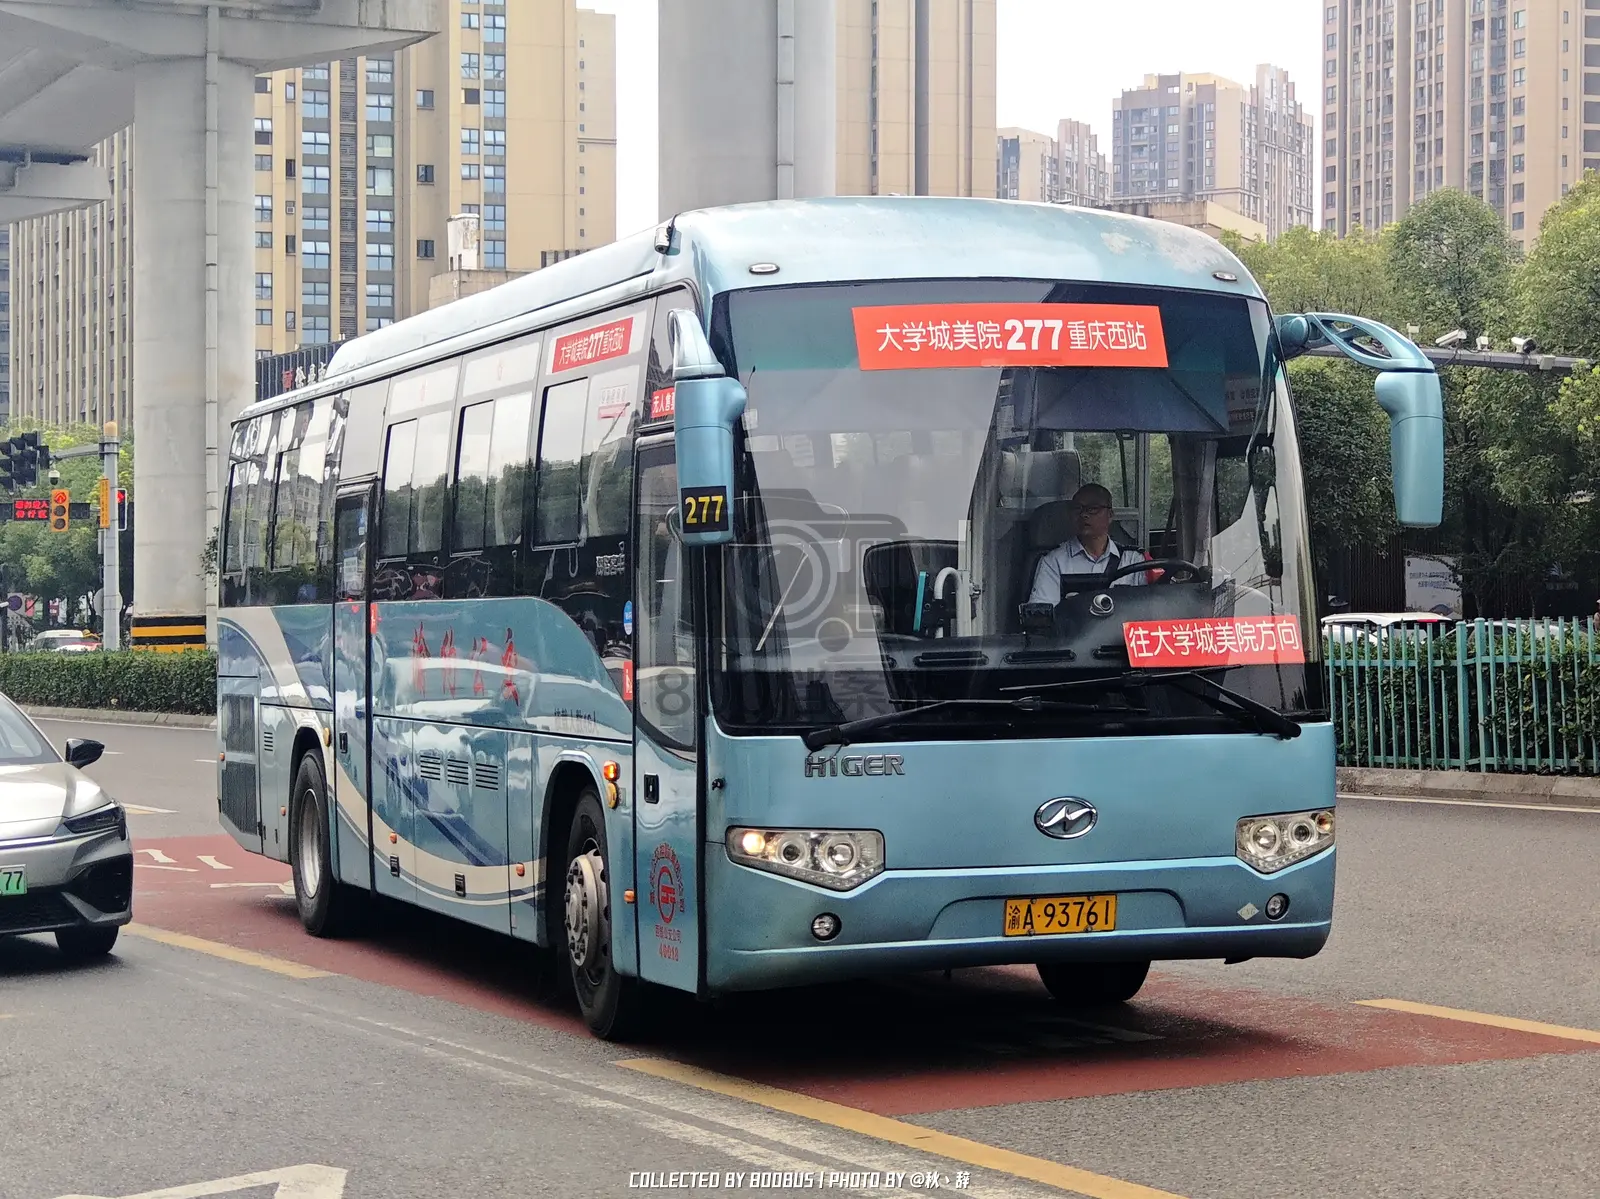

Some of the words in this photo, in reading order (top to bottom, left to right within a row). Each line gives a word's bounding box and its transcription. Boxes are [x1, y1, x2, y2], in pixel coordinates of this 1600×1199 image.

[652, 392, 674, 413] 无人售
[685, 495, 724, 524] 277
[1128, 620, 1300, 659] 往大学城美院方向
[804, 754, 905, 778] HIGER
